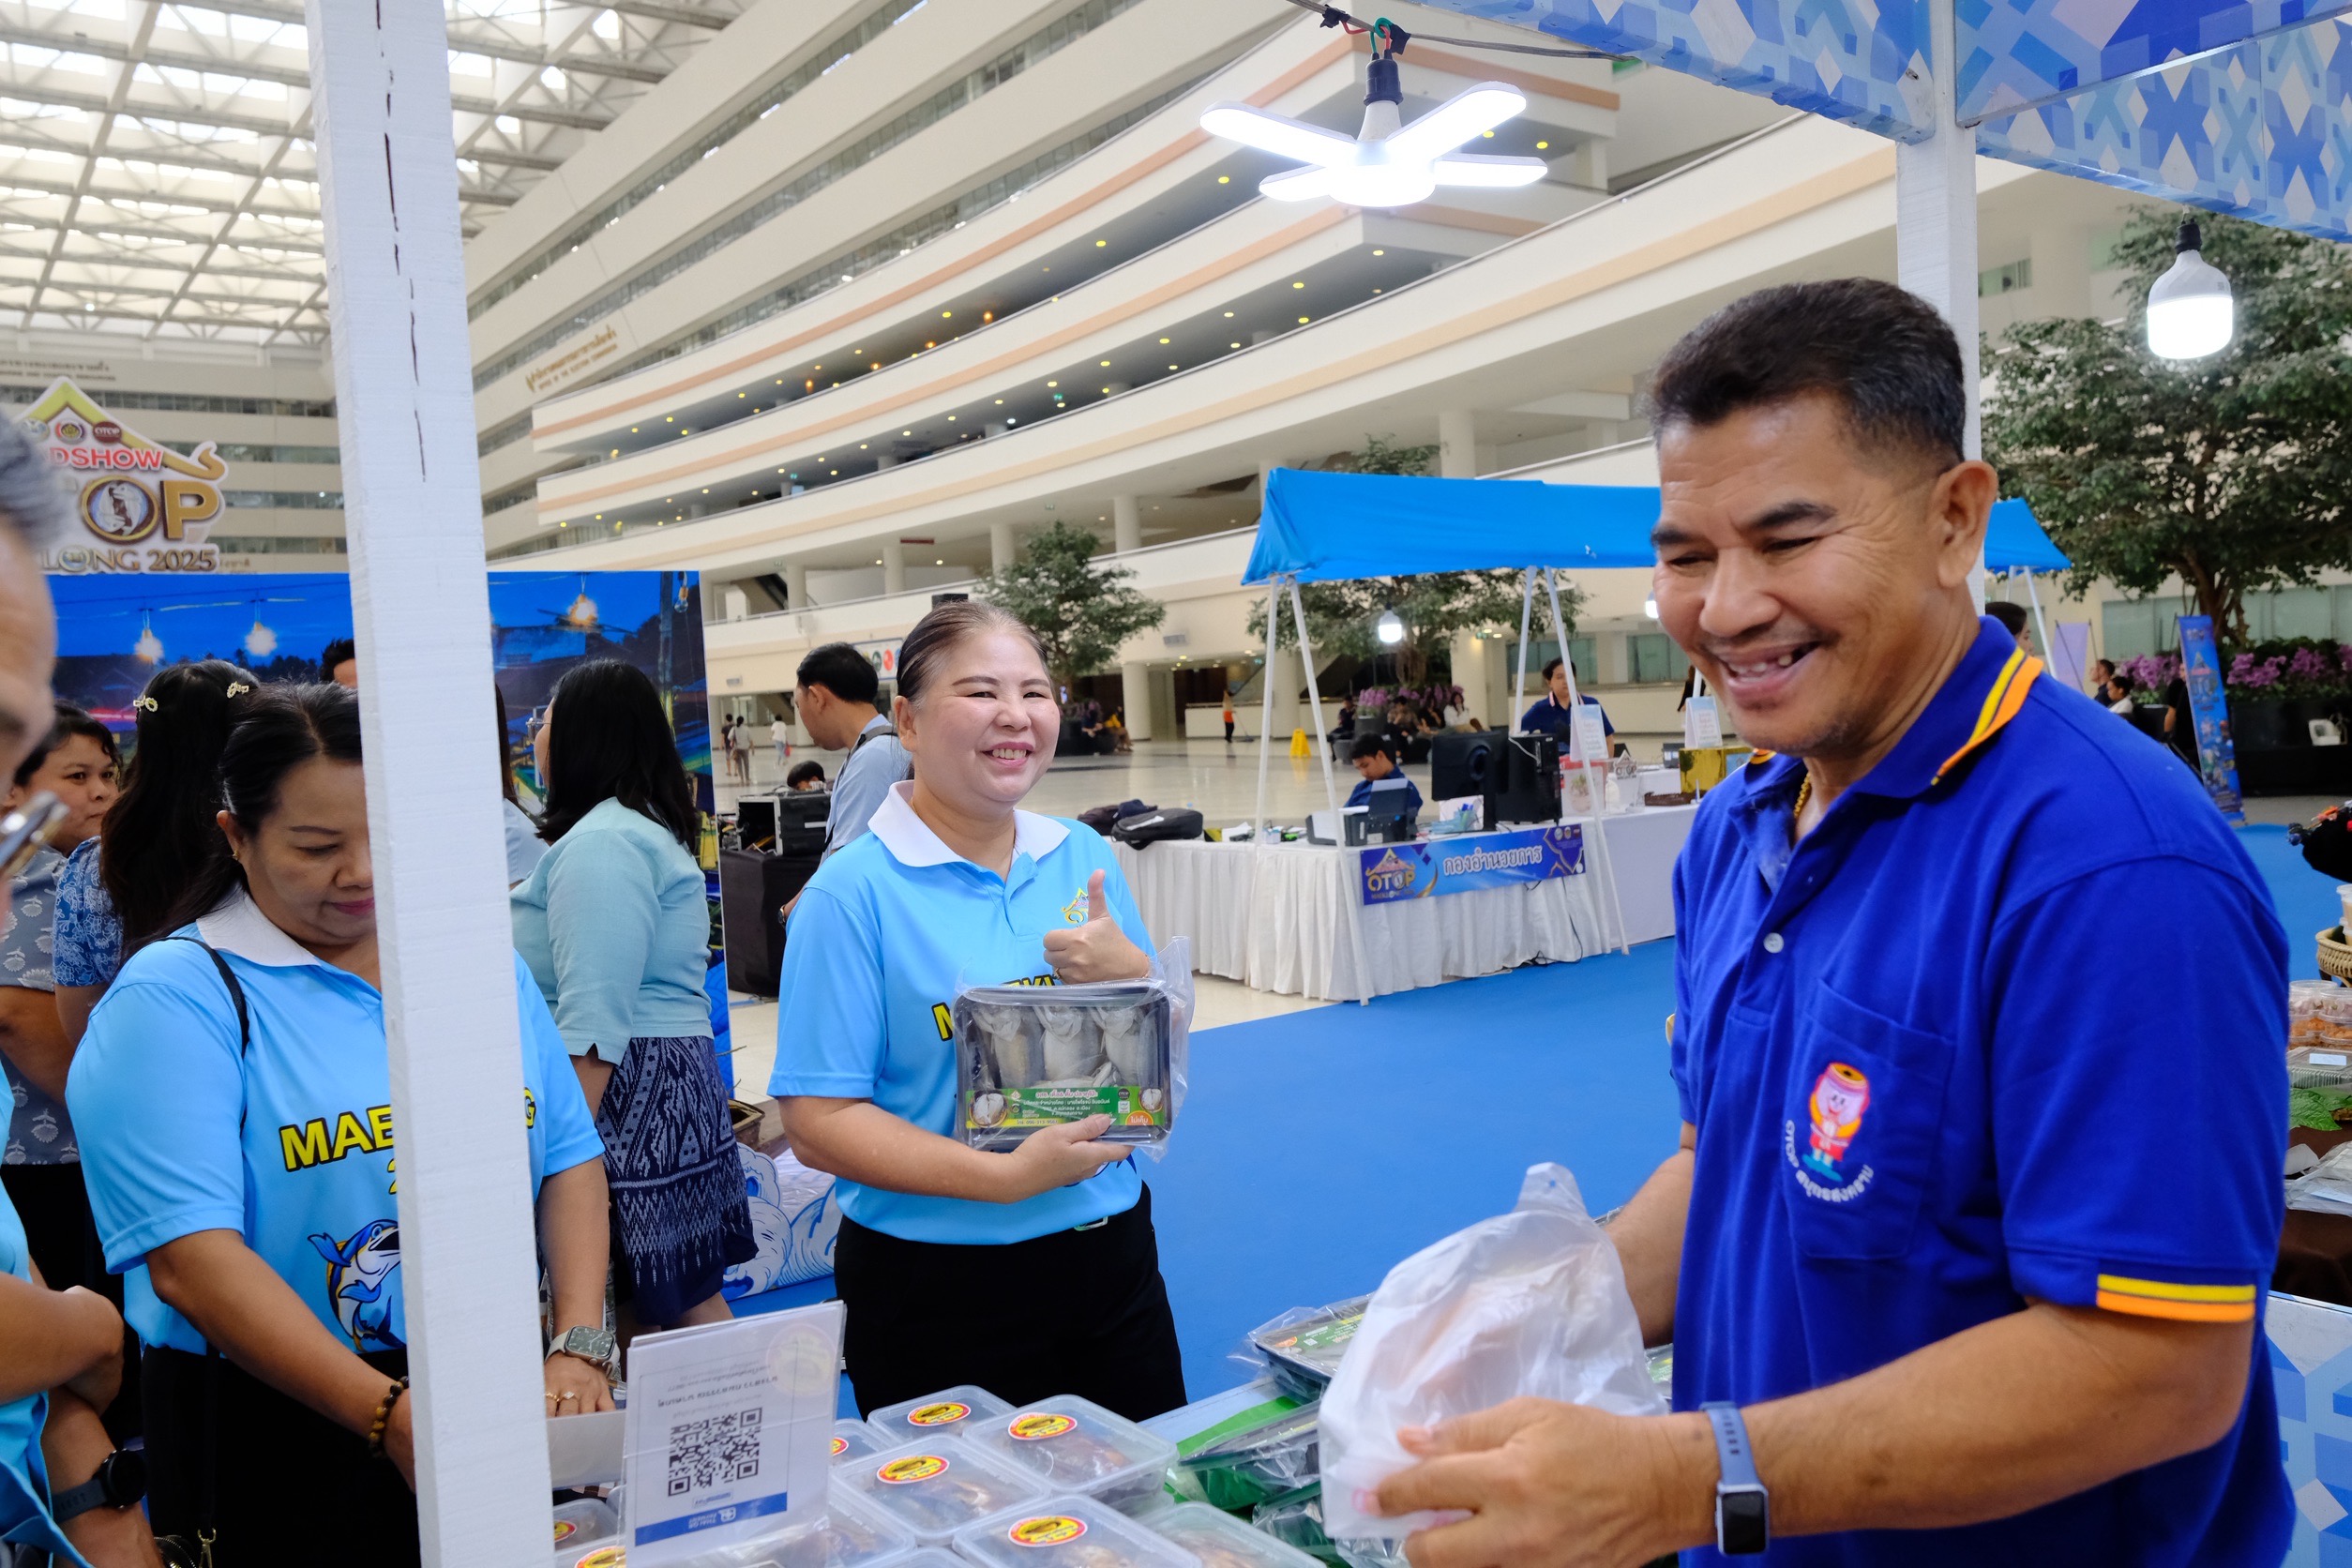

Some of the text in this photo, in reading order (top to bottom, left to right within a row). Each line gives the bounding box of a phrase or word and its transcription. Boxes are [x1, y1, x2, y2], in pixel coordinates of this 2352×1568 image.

[146, 547, 218, 572] 2025
[1442, 844, 1544, 877] กองอำนวยการ
[1367, 869, 1417, 893] OTOP
